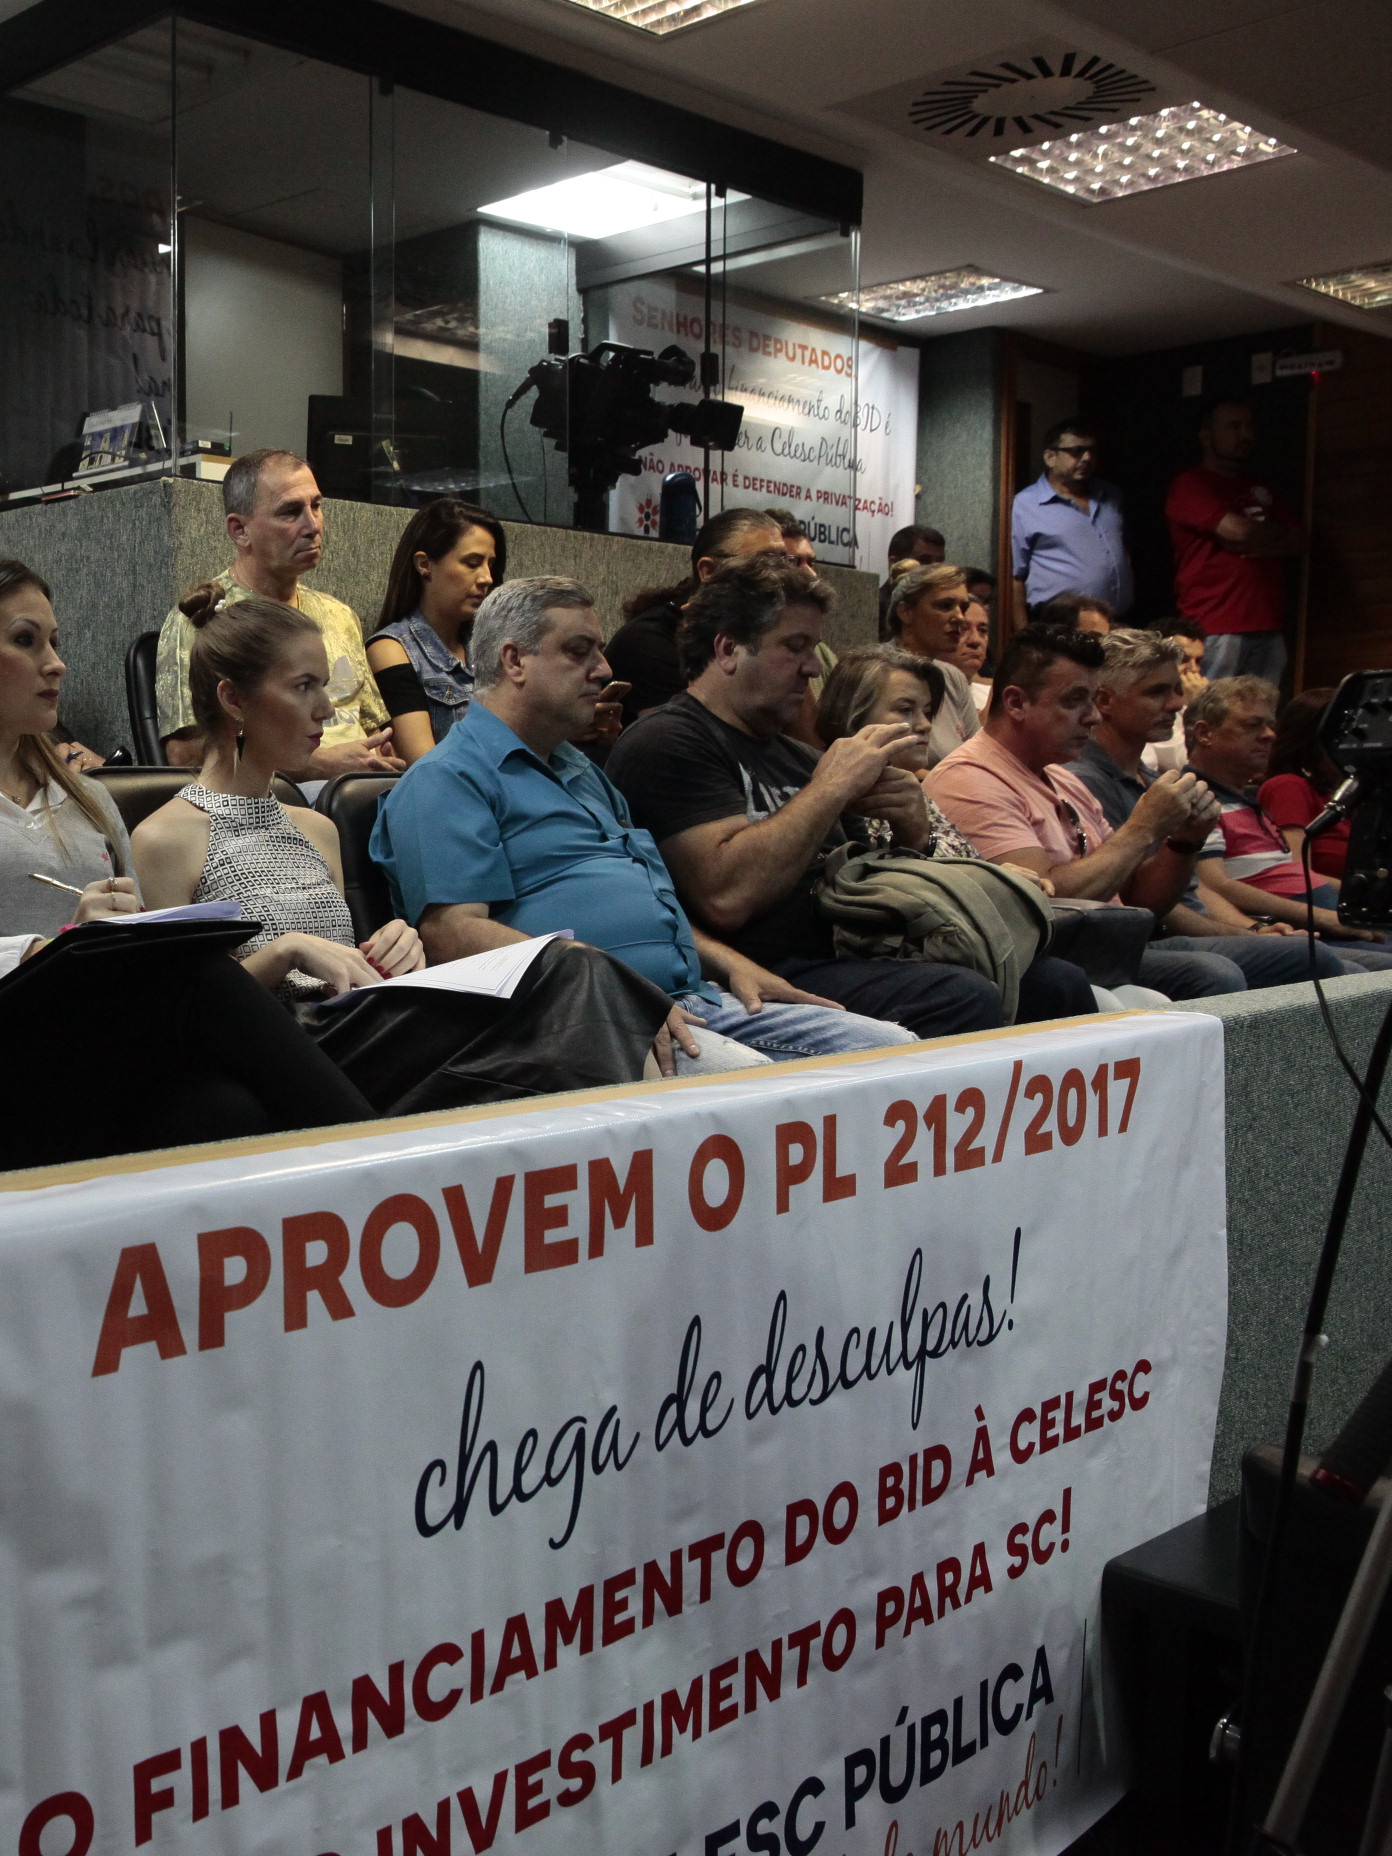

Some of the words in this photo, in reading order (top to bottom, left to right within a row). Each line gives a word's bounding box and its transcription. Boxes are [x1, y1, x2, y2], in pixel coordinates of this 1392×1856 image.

[638, 452, 665, 474] NÃO
[732, 468, 739, 488] É
[743, 476, 802, 499] DEFENDER
[804, 488, 812, 502] A
[816, 490, 894, 517] PRIVAZAÇÃO!
[756, 436, 767, 453] a
[771, 427, 816, 463] Celesc
[91, 1149, 654, 1378] APROVEM
[688, 1133, 745, 1232] O
[775, 1113, 857, 1215] PL
[883, 1057, 1141, 1191] 212/2017
[415, 1360, 639, 1551] chega
[653, 1314, 734, 1442] de
[745, 1227, 1022, 1430] desculpas!
[132, 1519, 765, 1849] FINANCIAMENTO
[784, 1480, 858, 1566] DO
[878, 1443, 952, 1528] BID
[965, 1404, 996, 1488] À
[1009, 1359, 1152, 1465] CELESC
[874, 1541, 993, 1651] PARA
[1006, 1487, 1073, 1580] SC!
[843, 1645, 1055, 1831] PÚBLICA
[932, 1714, 1064, 1856] mundo!
